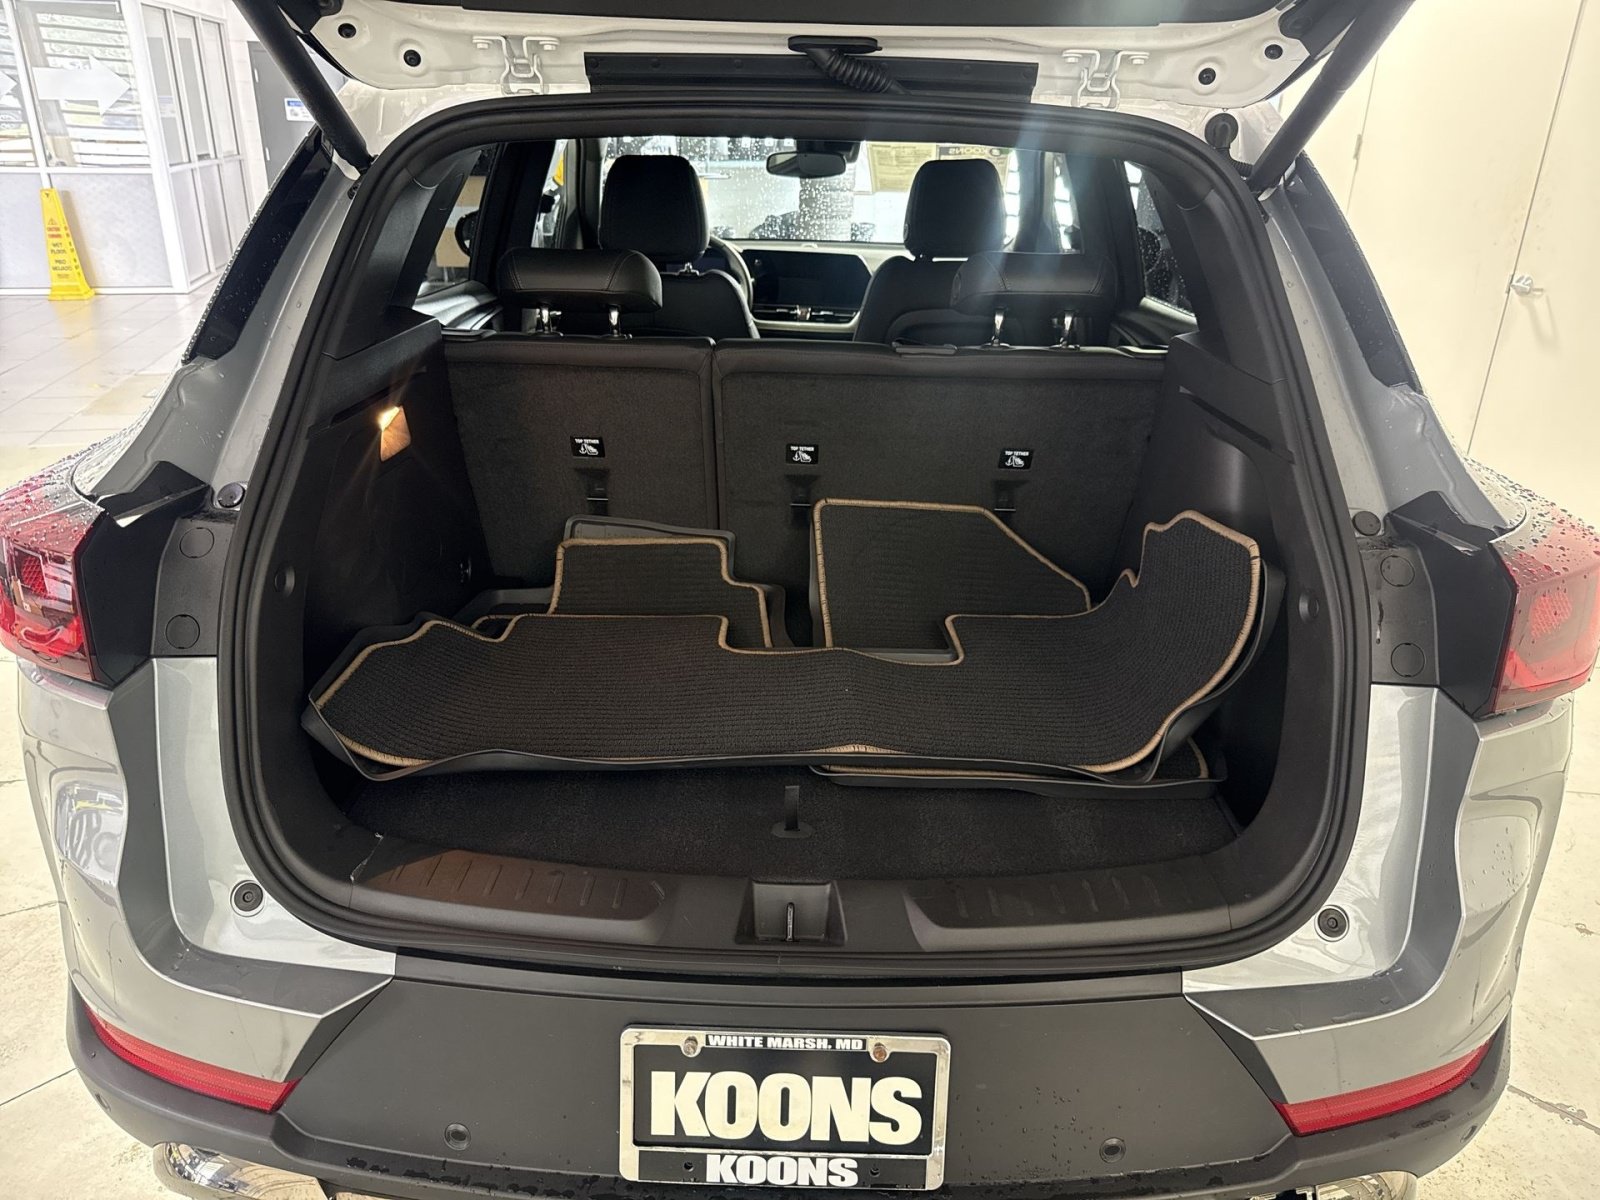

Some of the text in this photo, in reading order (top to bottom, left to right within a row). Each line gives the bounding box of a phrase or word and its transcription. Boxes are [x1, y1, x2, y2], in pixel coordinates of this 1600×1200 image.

[708, 1035, 763, 1048] WHITE
[836, 1039, 864, 1050] MD
[651, 1071, 923, 1145] KOONS
[706, 1154, 859, 1188] KOONS
